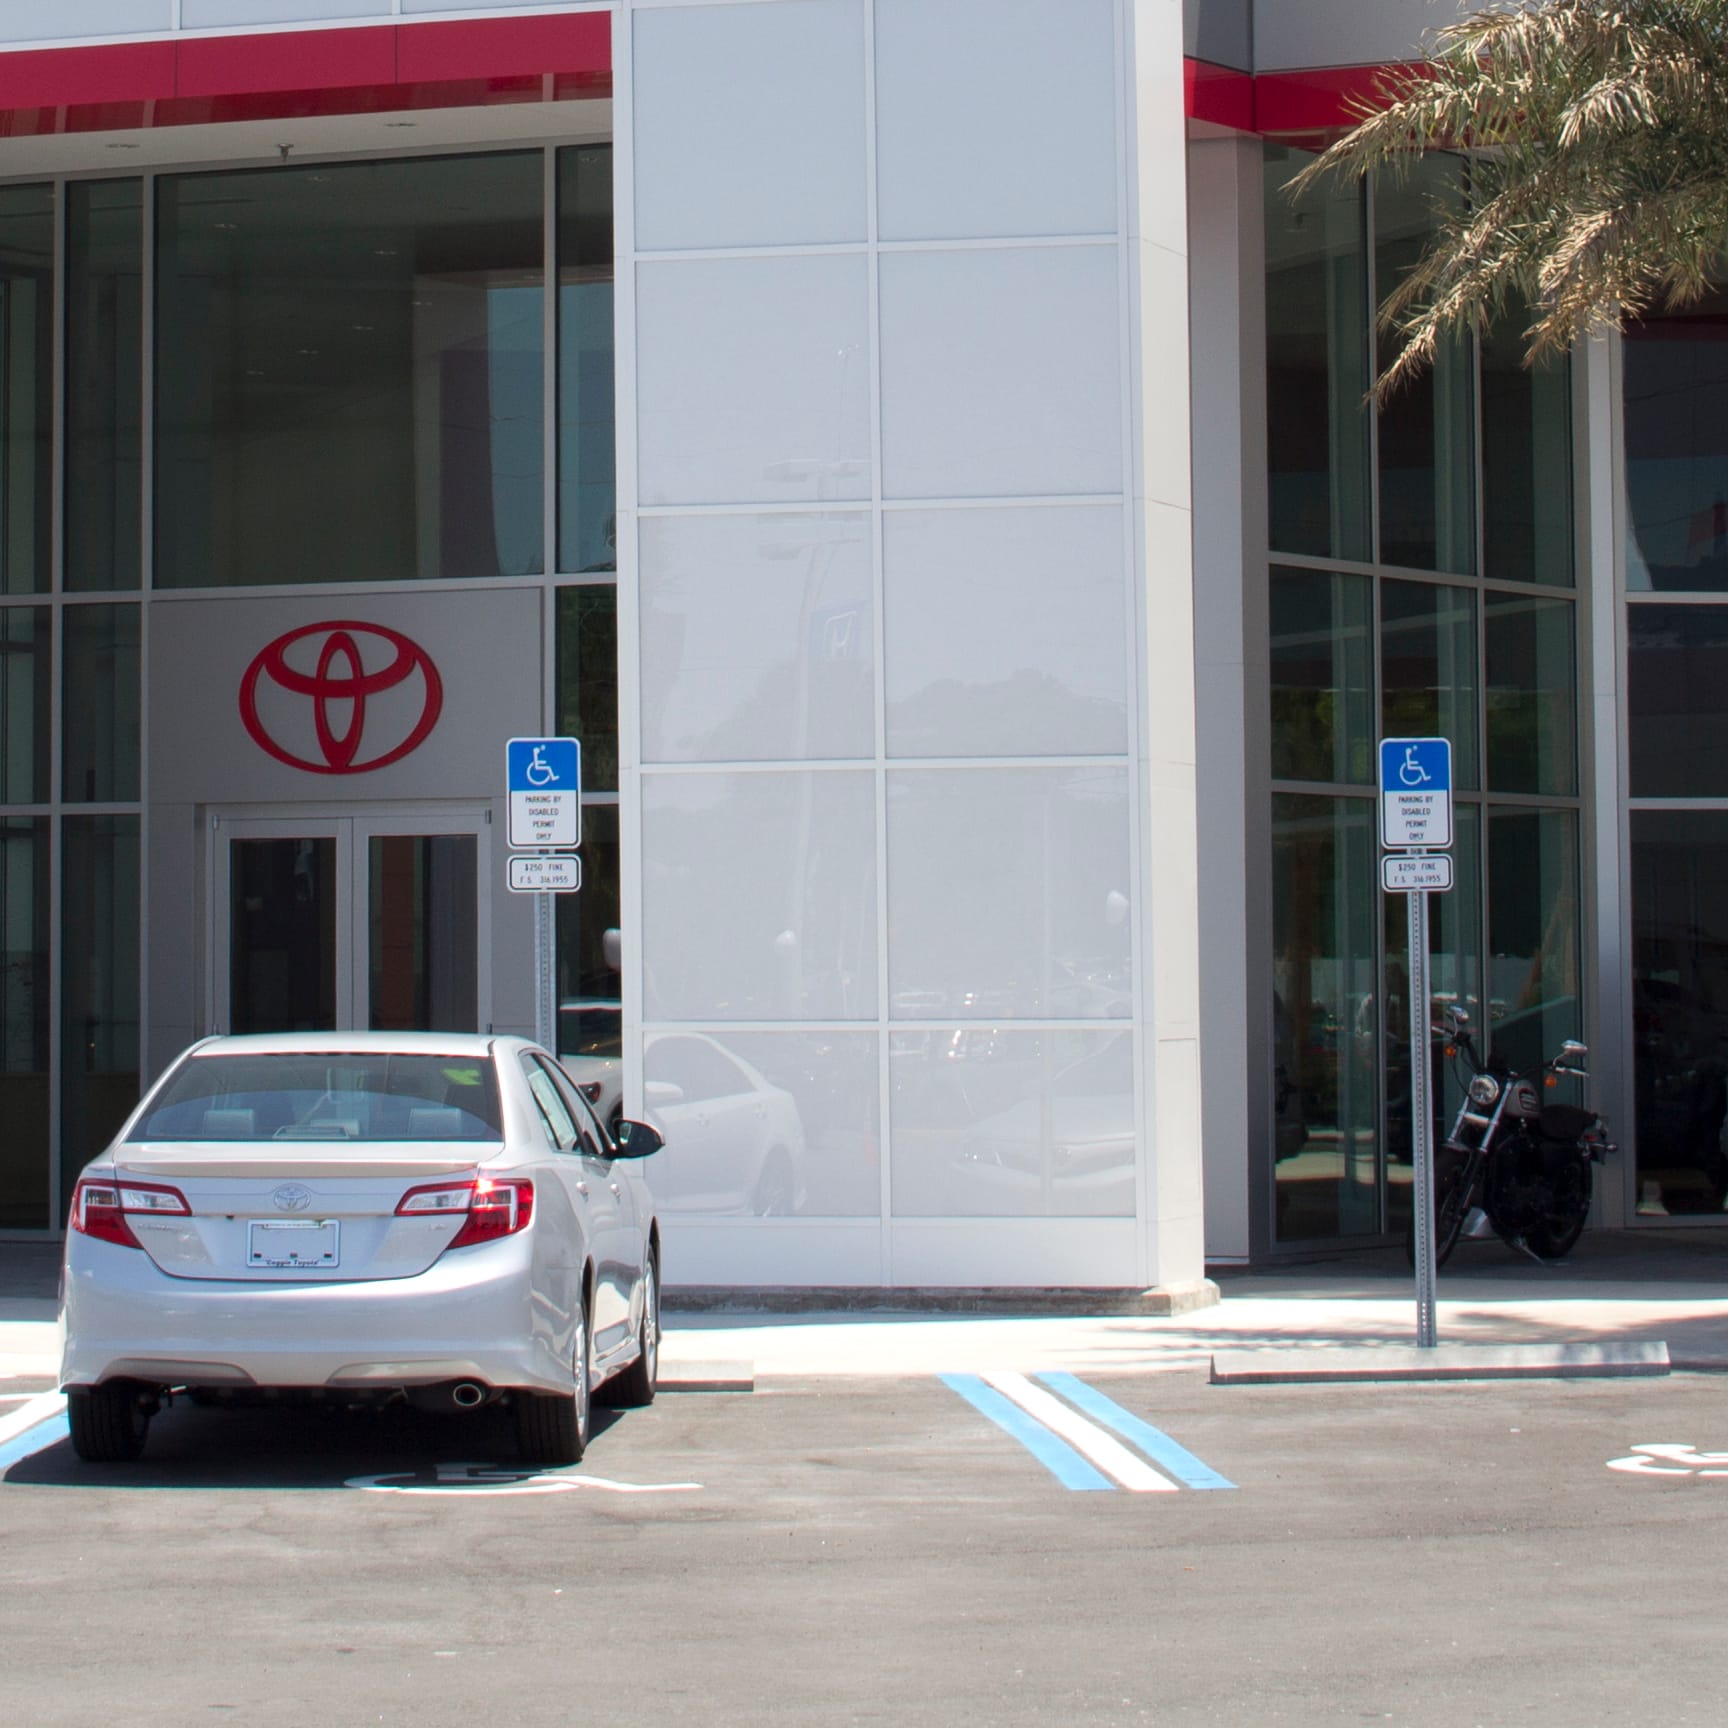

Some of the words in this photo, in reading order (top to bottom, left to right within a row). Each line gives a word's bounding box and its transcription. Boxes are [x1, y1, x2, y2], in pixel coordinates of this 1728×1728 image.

[525, 795, 551, 803] PARKING
[553, 795, 561, 803] BY
[1398, 795, 1423, 803] PARKING
[1425, 795, 1433, 803] BY
[528, 808, 559, 816] DISABLED
[1401, 808, 1431, 816] DISABLED
[532, 820, 555, 828] PERMIT
[1405, 820, 1427, 828] PERMIT
[525, 863, 543, 872] $250
[548, 863, 563, 871] FINE
[1398, 863, 1416, 872] $250
[1421, 863, 1437, 871] FINE
